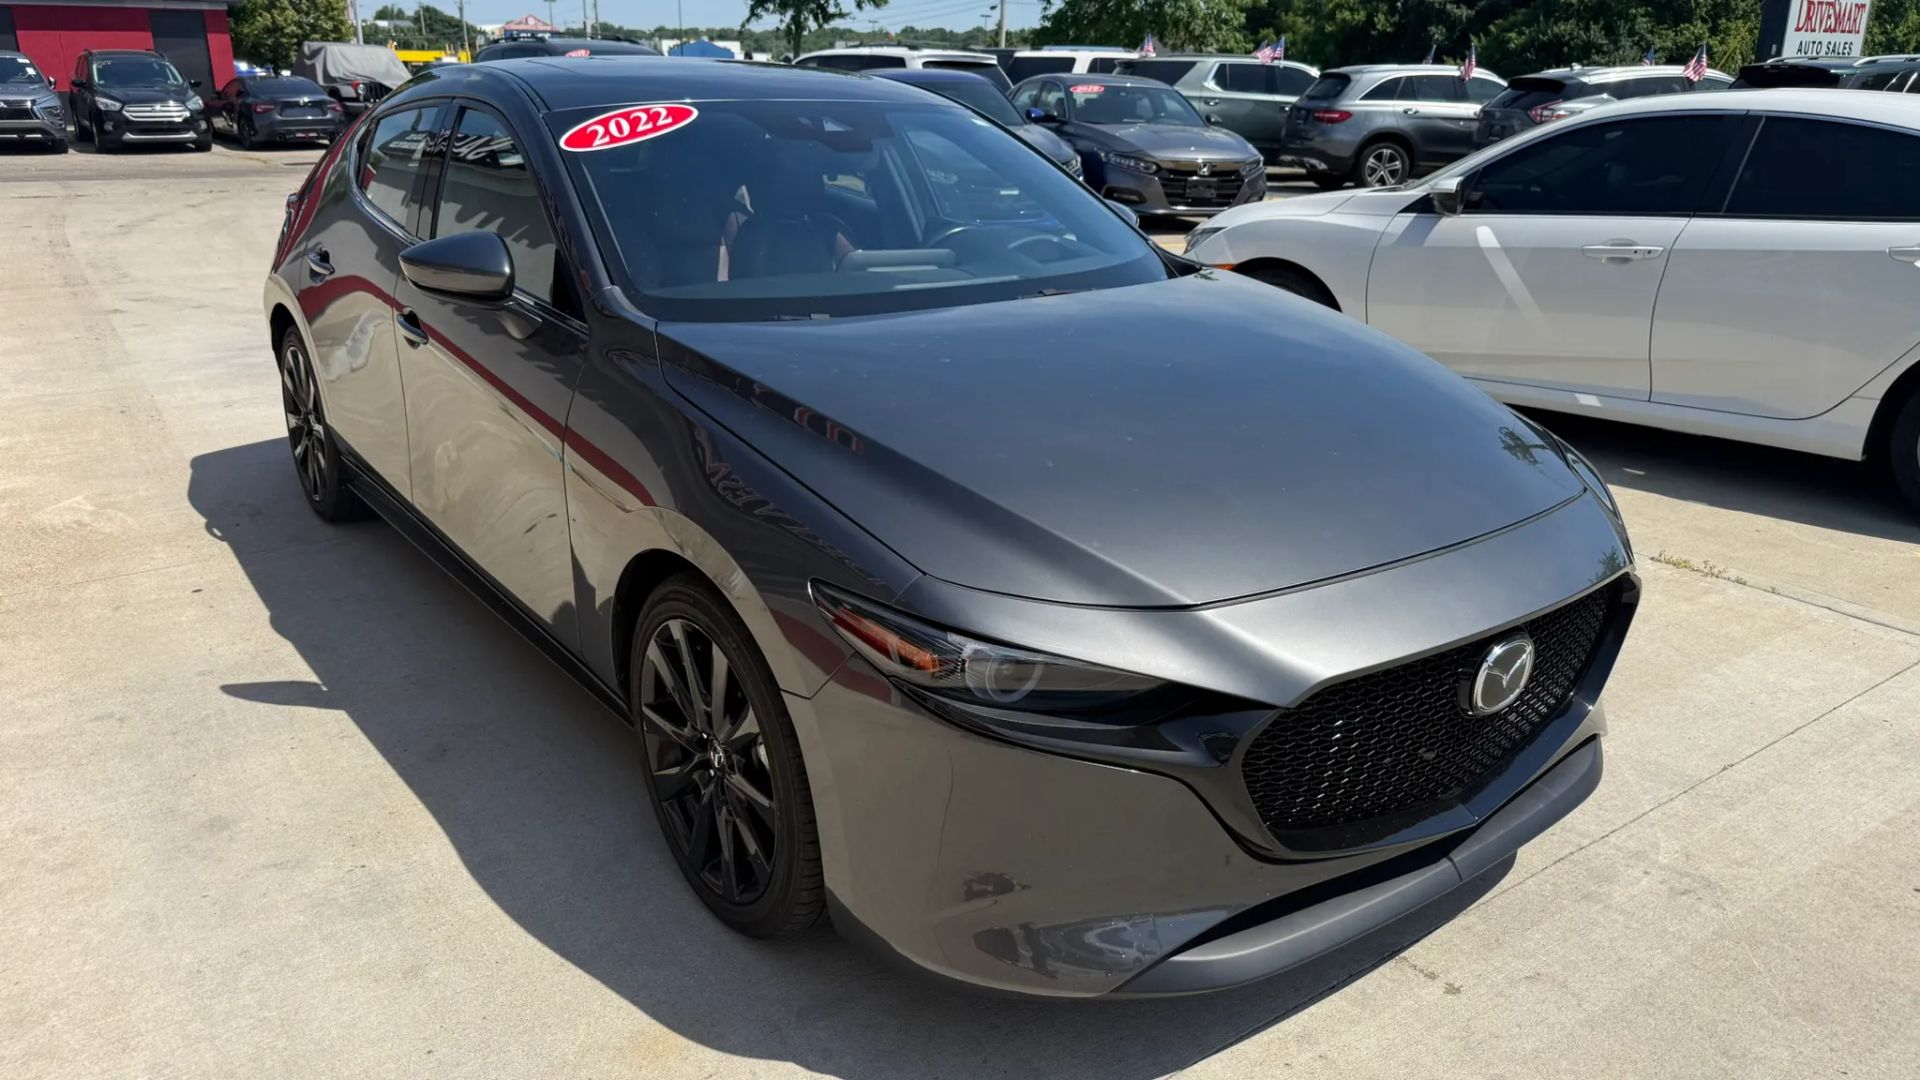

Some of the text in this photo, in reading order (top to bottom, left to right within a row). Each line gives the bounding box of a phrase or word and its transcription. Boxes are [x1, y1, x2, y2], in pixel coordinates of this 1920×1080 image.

[1796, 40, 1853, 56] AUTO SALES
[586, 107, 673, 147] 2022
